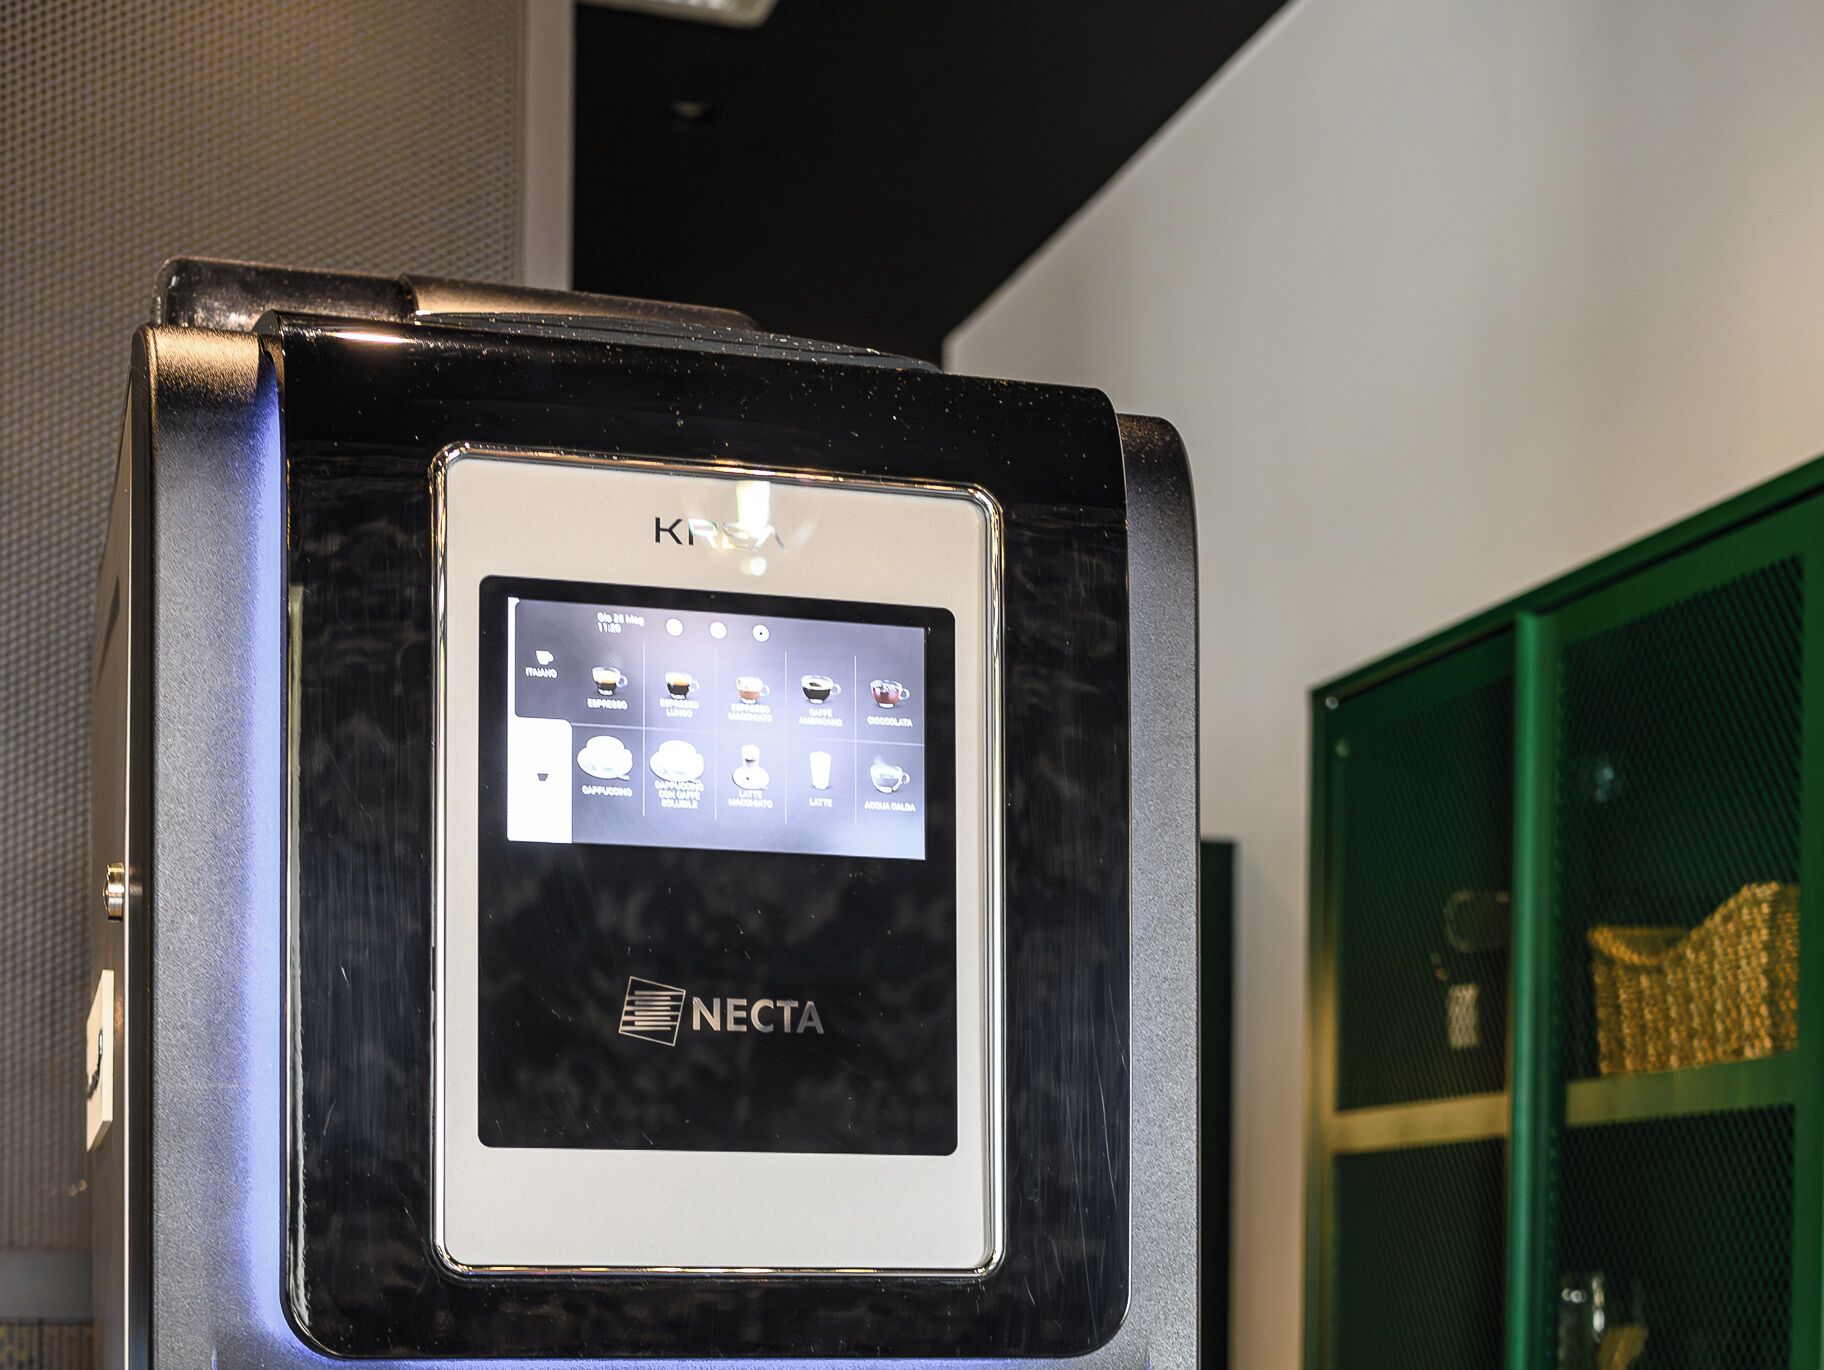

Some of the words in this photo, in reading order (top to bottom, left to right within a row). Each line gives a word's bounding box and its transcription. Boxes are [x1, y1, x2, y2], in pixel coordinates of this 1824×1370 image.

[587, 698, 628, 710] ESPRESSO
[660, 698, 700, 710] ESPRESSO
[666, 708, 693, 718] LUNGO
[728, 712, 773, 723] MACCHIATO
[799, 716, 843, 727] AMERICANO
[867, 716, 913, 727] CIOCCOLATA
[582, 785, 633, 797] CAPPUCCINO
[654, 780, 705, 792] CAPPUCCINO
[658, 790, 675, 799] CON
[739, 790, 763, 799] LATTE
[728, 798, 773, 809] MACCHIATO
[809, 797, 833, 807] LATTE
[864, 800, 890, 811] ACQUA
[891, 802, 916, 812] CALDA
[692, 997, 825, 1034] NECTA
